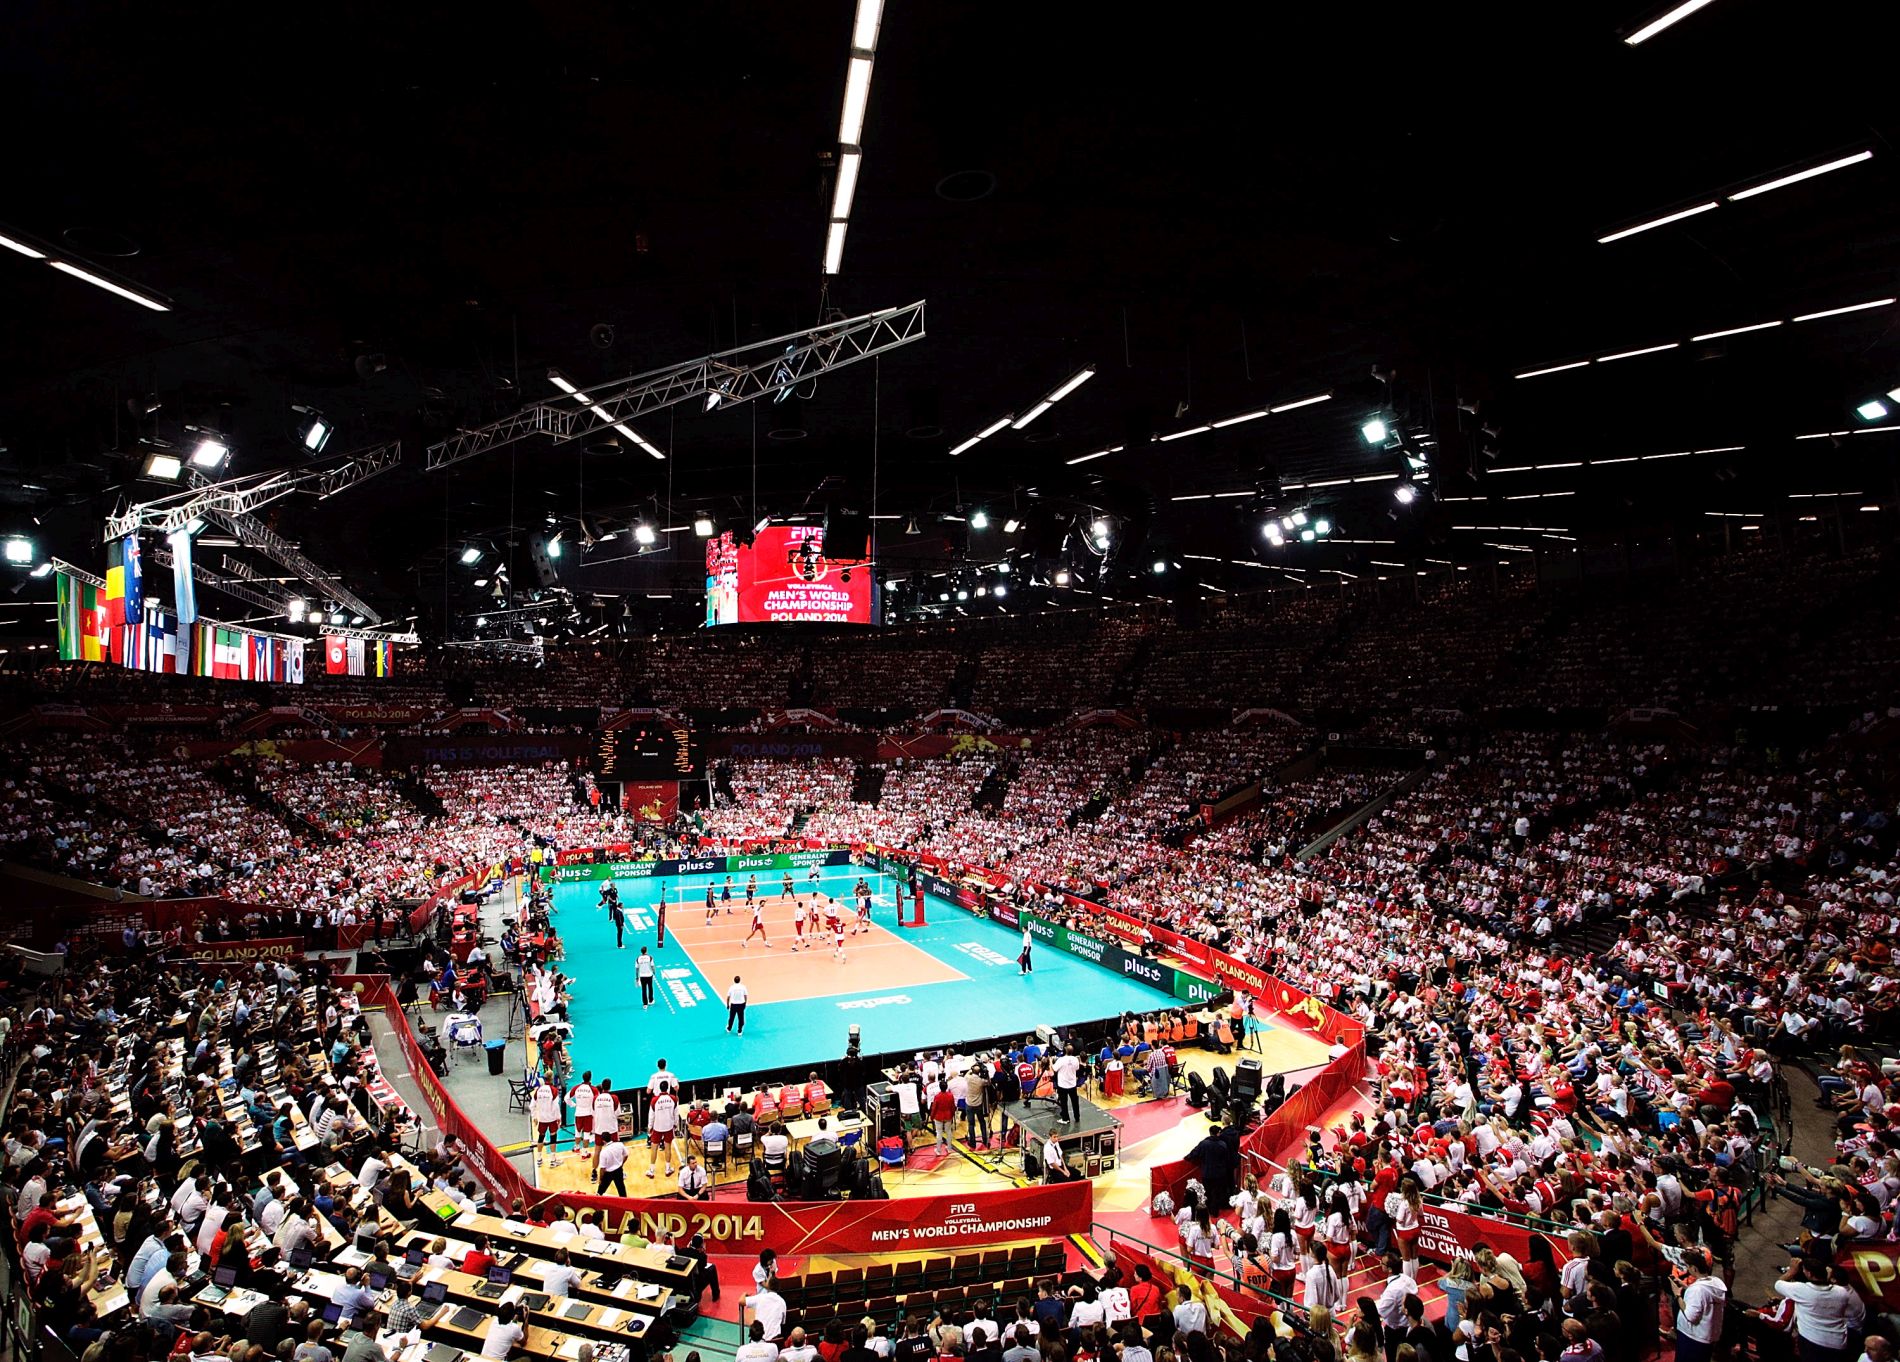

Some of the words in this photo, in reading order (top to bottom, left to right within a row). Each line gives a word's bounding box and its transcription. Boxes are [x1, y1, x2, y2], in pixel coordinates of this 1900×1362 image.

[768, 591, 807, 600] MEN'S
[809, 591, 849, 601] WORLD
[764, 601, 853, 611] CHAMPIONSHIP
[771, 612, 822, 622] POLAND
[823, 613, 848, 622] 2014
[345, 710, 387, 719] POLAND
[388, 710, 410, 719] 2014
[731, 744, 790, 756] POLAND
[791, 743, 822, 755] 2014
[610, 862, 656, 871] GENERALNY
[679, 861, 705, 872] plus
[739, 858, 764, 868] plus
[793, 859, 826, 867] SPONSOR
[614, 869, 652, 877] SPONSOR
[933, 883, 946, 895] plus
[1028, 921, 1047, 936] plus
[1067, 932, 1105, 953] GENERALNY
[260, 945, 295, 957] 2014
[1070, 942, 1101, 961] SPONSOR
[1124, 958, 1150, 978] plus
[1215, 959, 1246, 982] POLAND
[1245, 971, 1264, 989] 2014
[1188, 984, 1217, 1001] plu
[950, 1203, 976, 1214] FIVB
[691, 1213, 765, 1240] 2014
[944, 1217, 981, 1225] VOLLEYBALL
[1423, 1213, 1449, 1229] FIVB
[871, 1229, 910, 1241] MEN'S
[913, 1225, 957, 1237] WORLD
[960, 1216, 1051, 1234] CHAMPIONSHIP
[1420, 1229, 1459, 1244] VOLLEYBALL
[1247, 1275, 1267, 1285] FOTO
[1850, 1251, 1900, 1297] P
